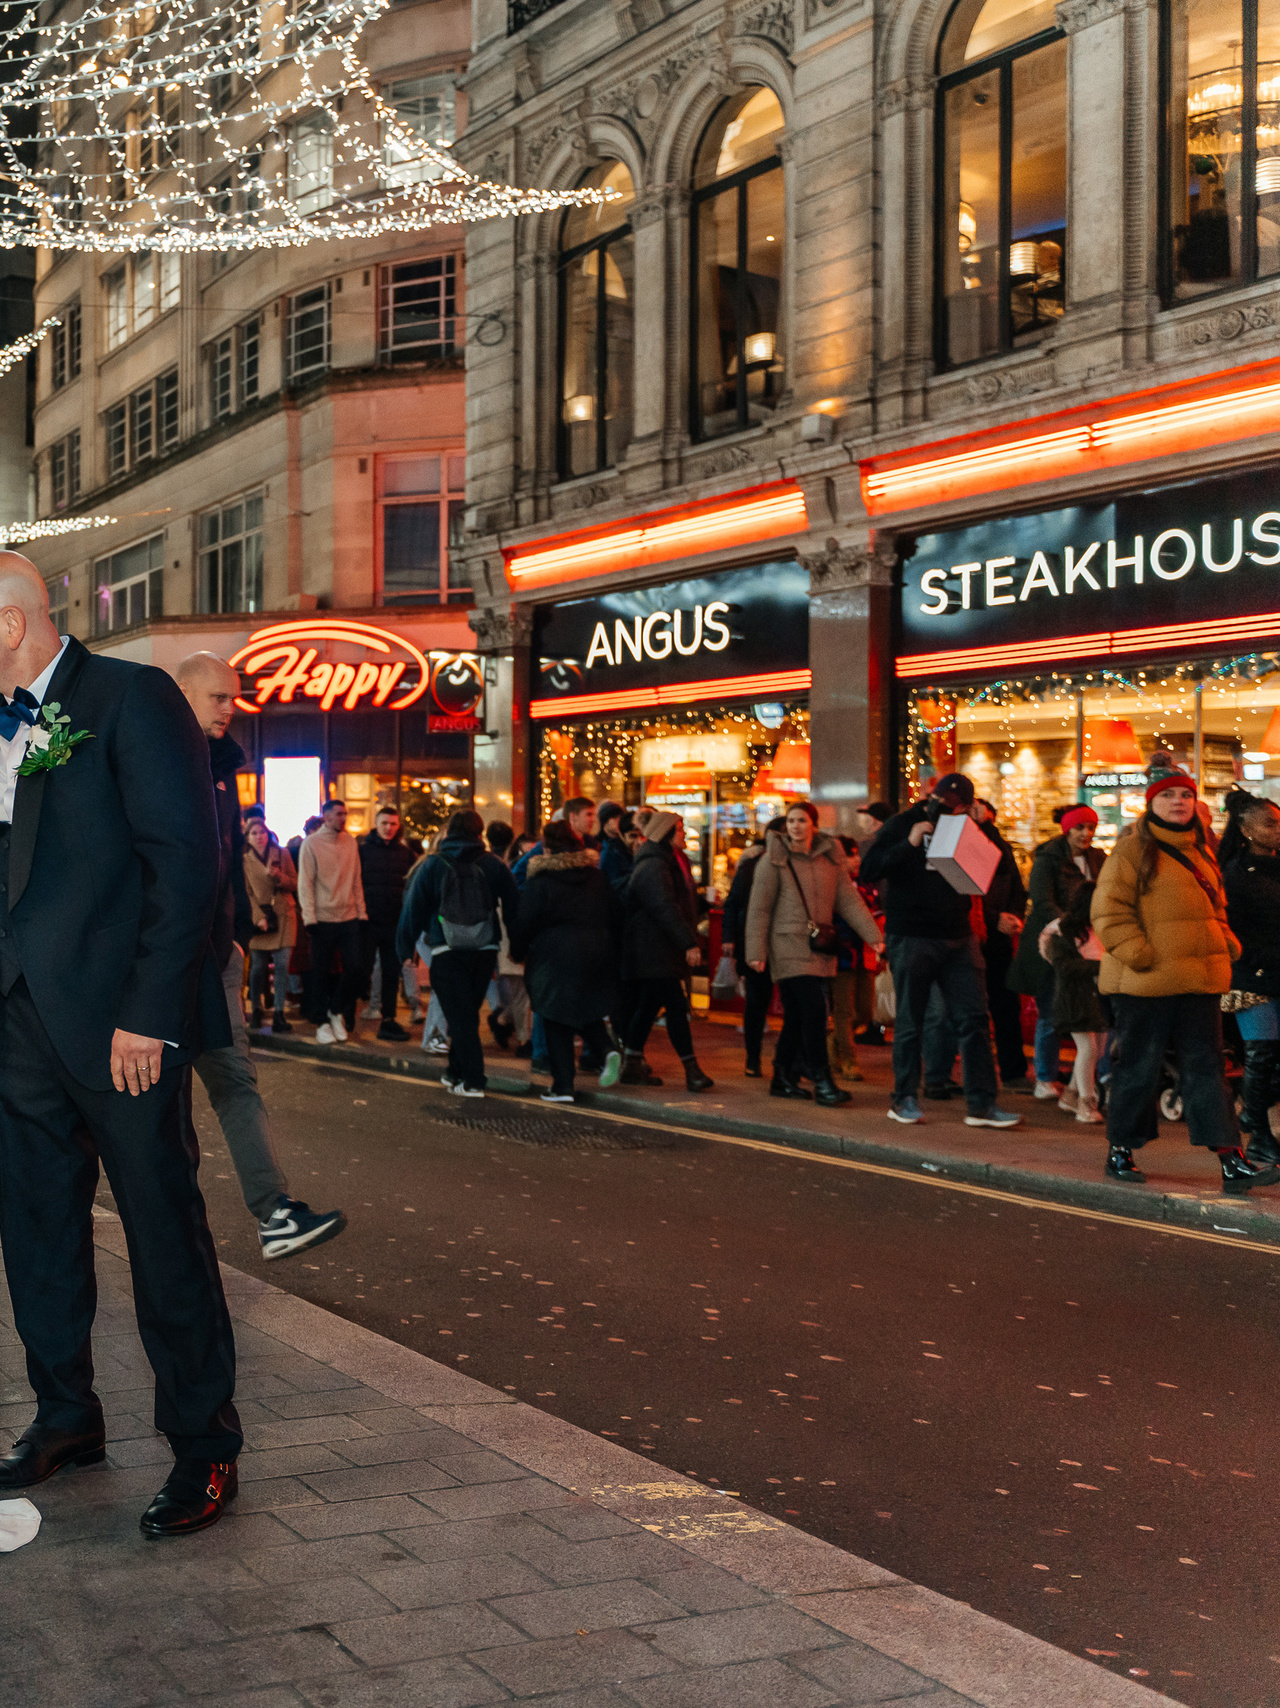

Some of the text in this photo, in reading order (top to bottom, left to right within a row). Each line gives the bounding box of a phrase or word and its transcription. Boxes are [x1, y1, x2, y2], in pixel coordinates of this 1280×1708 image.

[585, 600, 731, 669] ANGUS
[244, 645, 407, 712] Happy
[1084, 773, 1149, 787] ANGUS STEA
